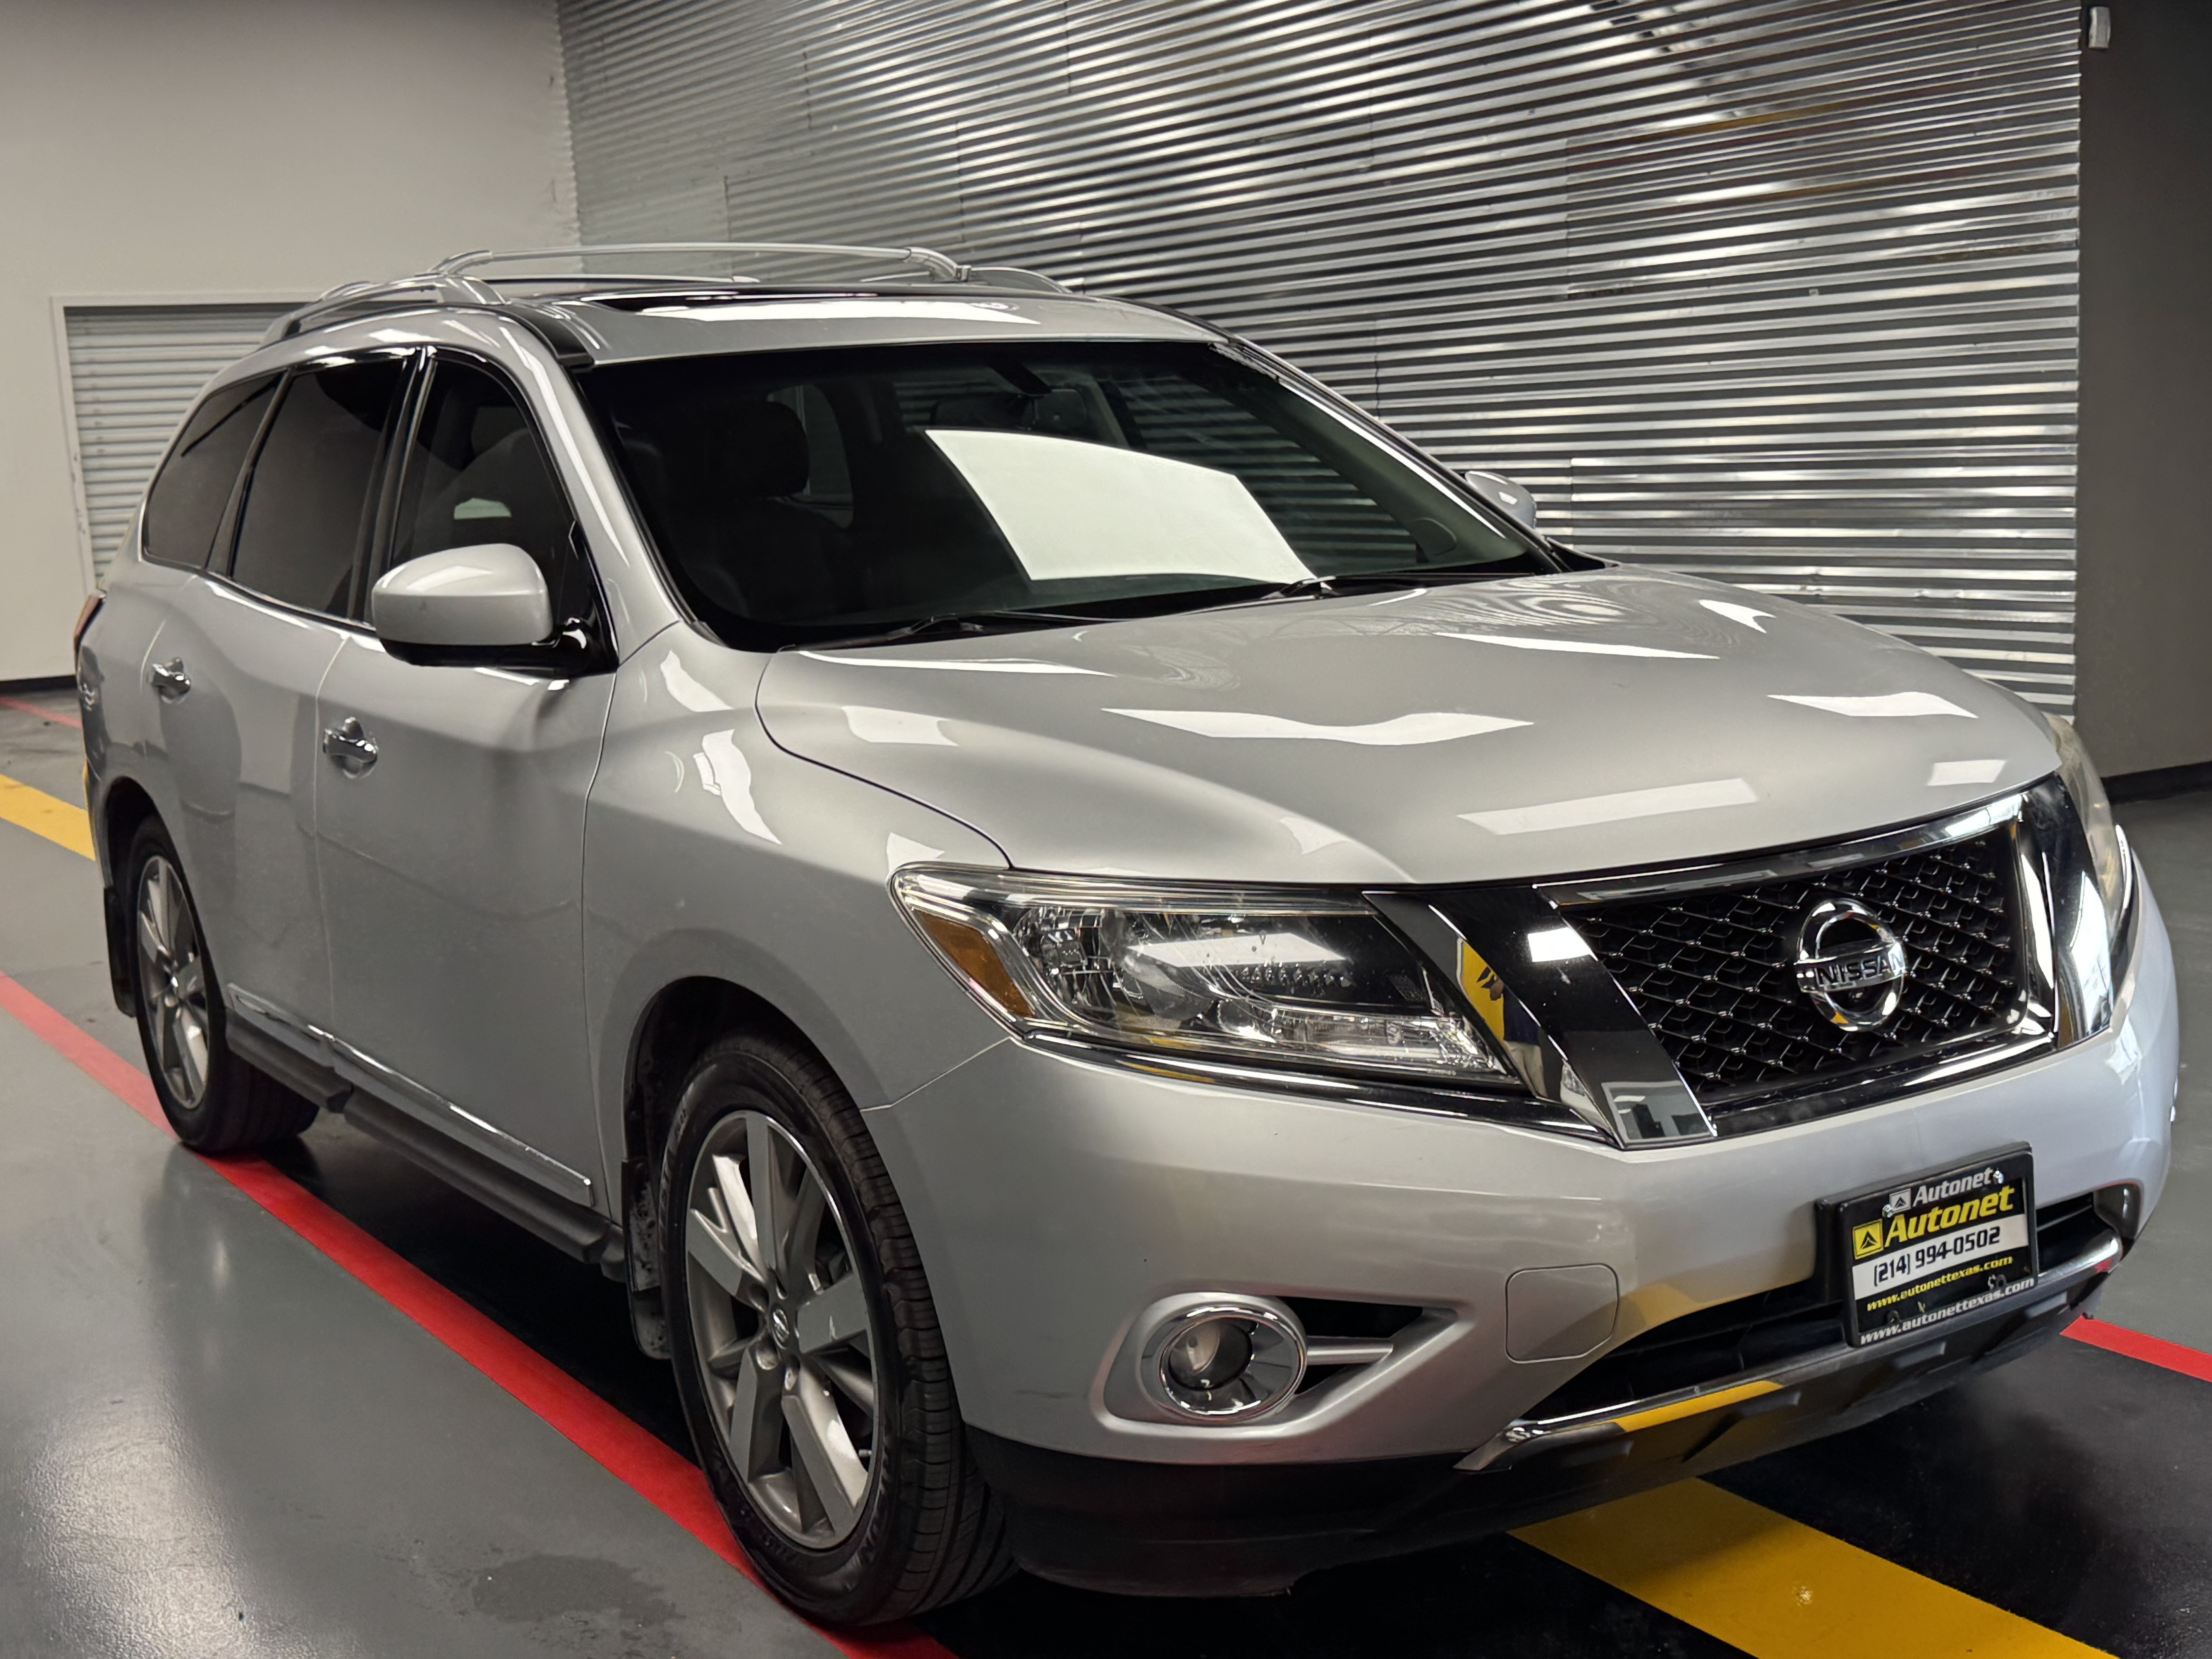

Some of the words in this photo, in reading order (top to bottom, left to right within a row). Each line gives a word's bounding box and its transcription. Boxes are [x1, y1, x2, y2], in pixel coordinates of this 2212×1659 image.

[1815, 952, 1905, 986] NISSAN
[1884, 1185, 2015, 1247] Autonet
[1913, 1167, 1993, 1207] Autonet
[1867, 1256, 2013, 1311] www.autonettexas.com
[1874, 1253, 1910, 1287] (214)
[1915, 1226, 2000, 1269] 994-0502
[1860, 1278, 2034, 1345] www.autonettexas.com
